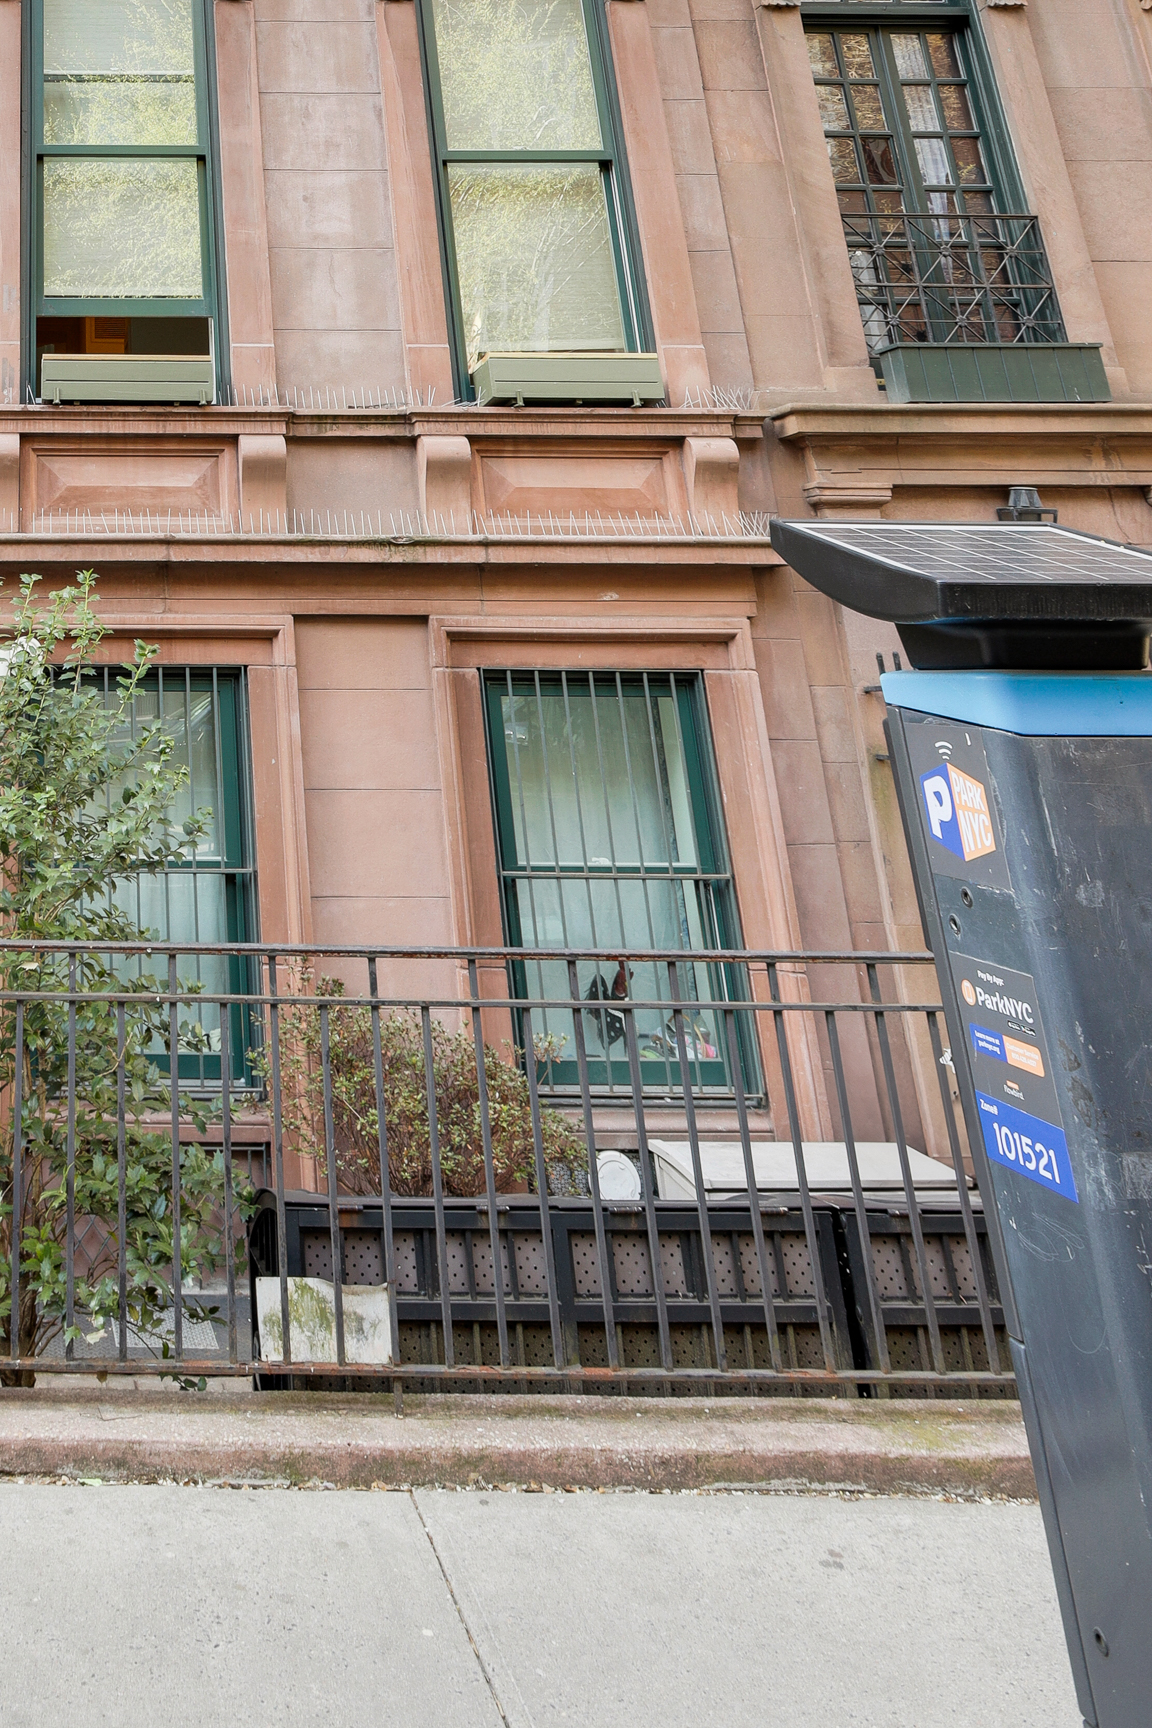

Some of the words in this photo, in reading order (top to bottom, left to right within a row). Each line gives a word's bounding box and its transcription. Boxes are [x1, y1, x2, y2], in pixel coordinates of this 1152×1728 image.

[923, 775, 953, 840] P
[950, 770, 986, 812] PARK
[958, 809, 992, 853] NYC
[977, 969, 987, 982] Pay
[975, 986, 1034, 1024] ParkNYC
[992, 1122, 1061, 1184] 101521
